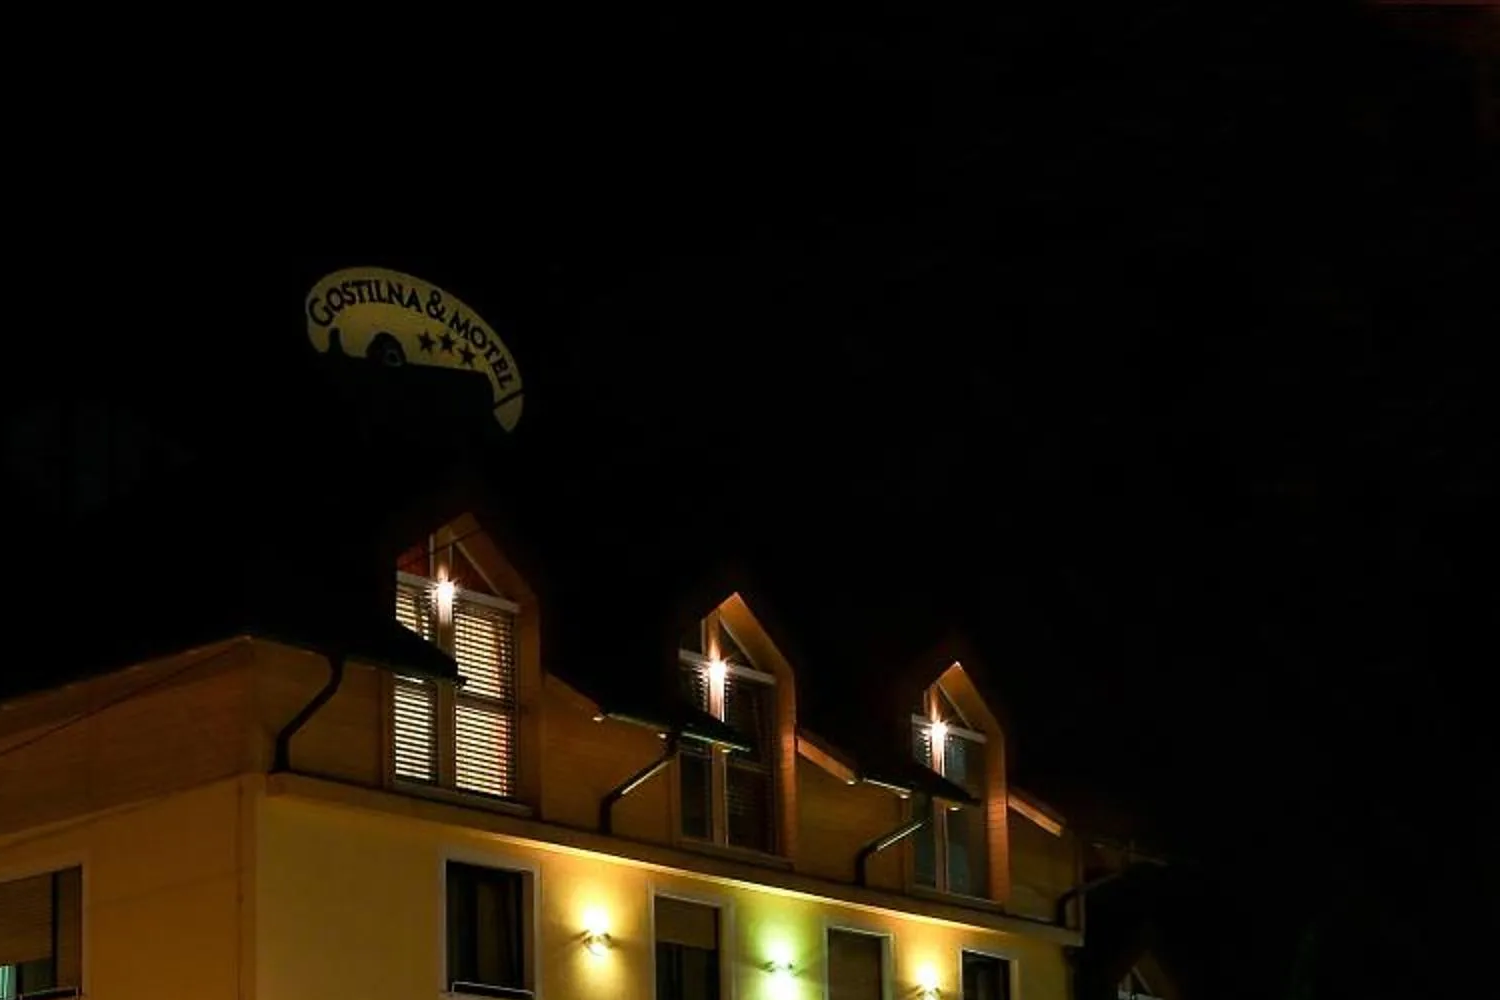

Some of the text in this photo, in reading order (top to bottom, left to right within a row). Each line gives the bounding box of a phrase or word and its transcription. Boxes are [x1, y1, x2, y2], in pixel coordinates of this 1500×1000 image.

[309, 279, 514, 390] GOSTILNA & MOTEL
